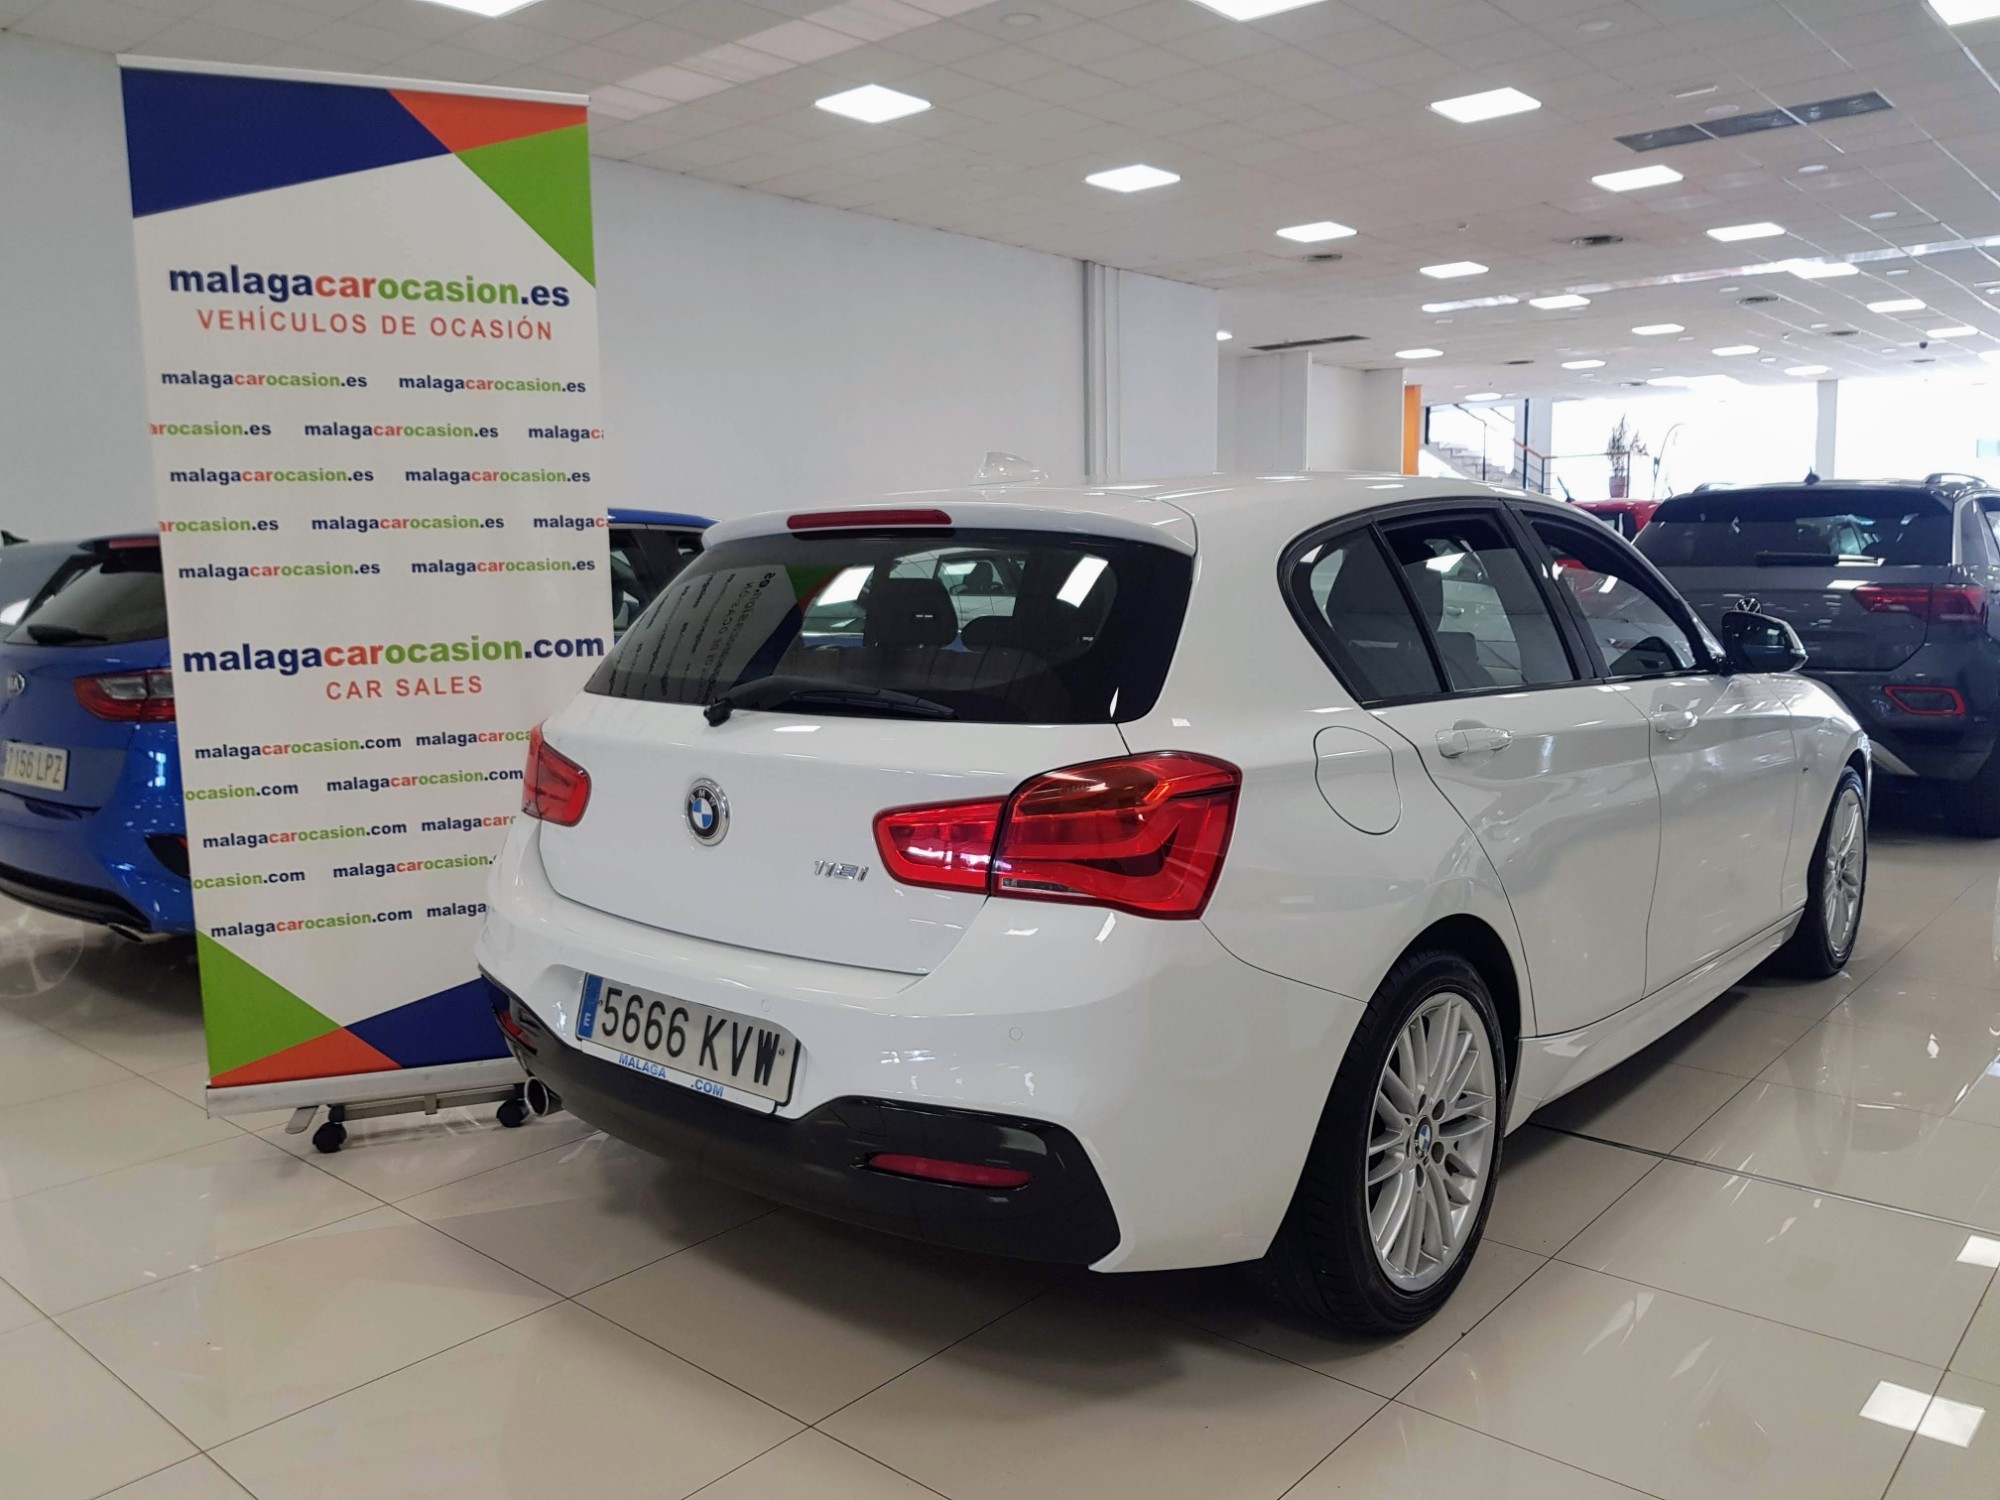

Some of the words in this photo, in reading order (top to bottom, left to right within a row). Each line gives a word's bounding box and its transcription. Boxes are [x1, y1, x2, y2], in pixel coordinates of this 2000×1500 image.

[169, 265, 570, 307] malagacarocasion.es
[198, 306, 366, 333] VEHÍCULOS
[382, 315, 416, 335] DE
[431, 316, 551, 340] OCASIÓN
[162, 370, 367, 389] malagacarocasion.es
[399, 375, 586, 393] malagacarocasion.es
[305, 422, 498, 439] malagacarocasion.es
[529, 425, 604, 442] malagac
[170, 468, 374, 486] malagacarocasion.es
[405, 468, 590, 485] malagacarocasion.es
[312, 515, 504, 533] malagacarocasion.es
[179, 562, 380, 581] malagacarocasion.es
[412, 559, 595, 576] malagacarocasion.es
[183, 635, 604, 675] malagacarocasion.com
[326, 680, 383, 700] CAR
[396, 675, 482, 697] SALES
[195, 738, 401, 759] malagacarocasion.com
[186, 782, 298, 801] ocasion.com
[327, 767, 523, 793] malagacarocasion.com
[203, 824, 407, 848] malagacarocasion.com
[193, 871, 305, 890] ocasion.com
[333, 855, 496, 878] malagacarocasion.
[211, 908, 412, 938] malagacarocasion.com
[427, 903, 487, 917] malaga
[583, 1012, 591, 1027] E
[601, 987, 689, 1058] 5666
[698, 1015, 780, 1086] KVW
[618, 1054, 667, 1079] MALAGA
[690, 1079, 724, 1098] .COM
